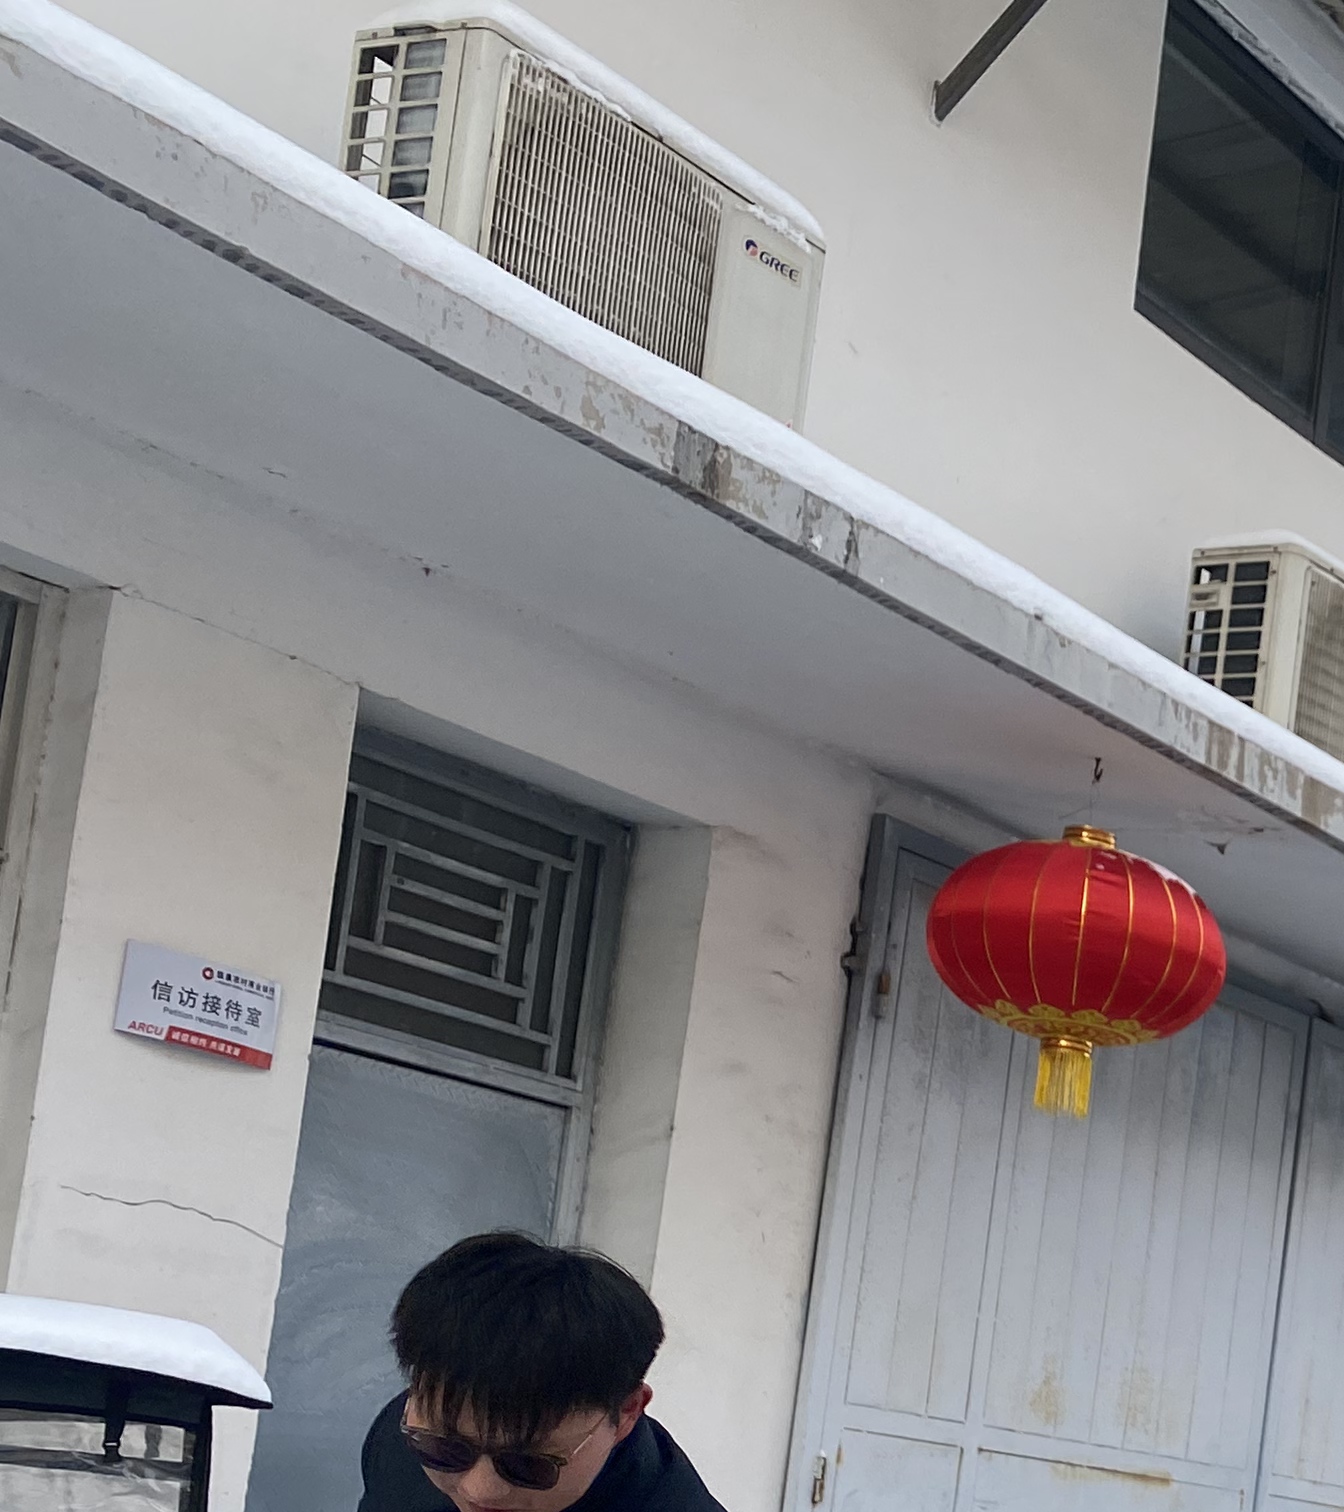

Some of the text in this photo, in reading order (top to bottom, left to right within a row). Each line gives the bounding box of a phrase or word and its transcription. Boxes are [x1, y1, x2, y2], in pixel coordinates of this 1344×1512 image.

[759, 251, 799, 282] GREE
[151, 979, 264, 1029] 信访接待室
[163, 1006, 194, 1021] Petition
[128, 1020, 163, 1037] ARCU
